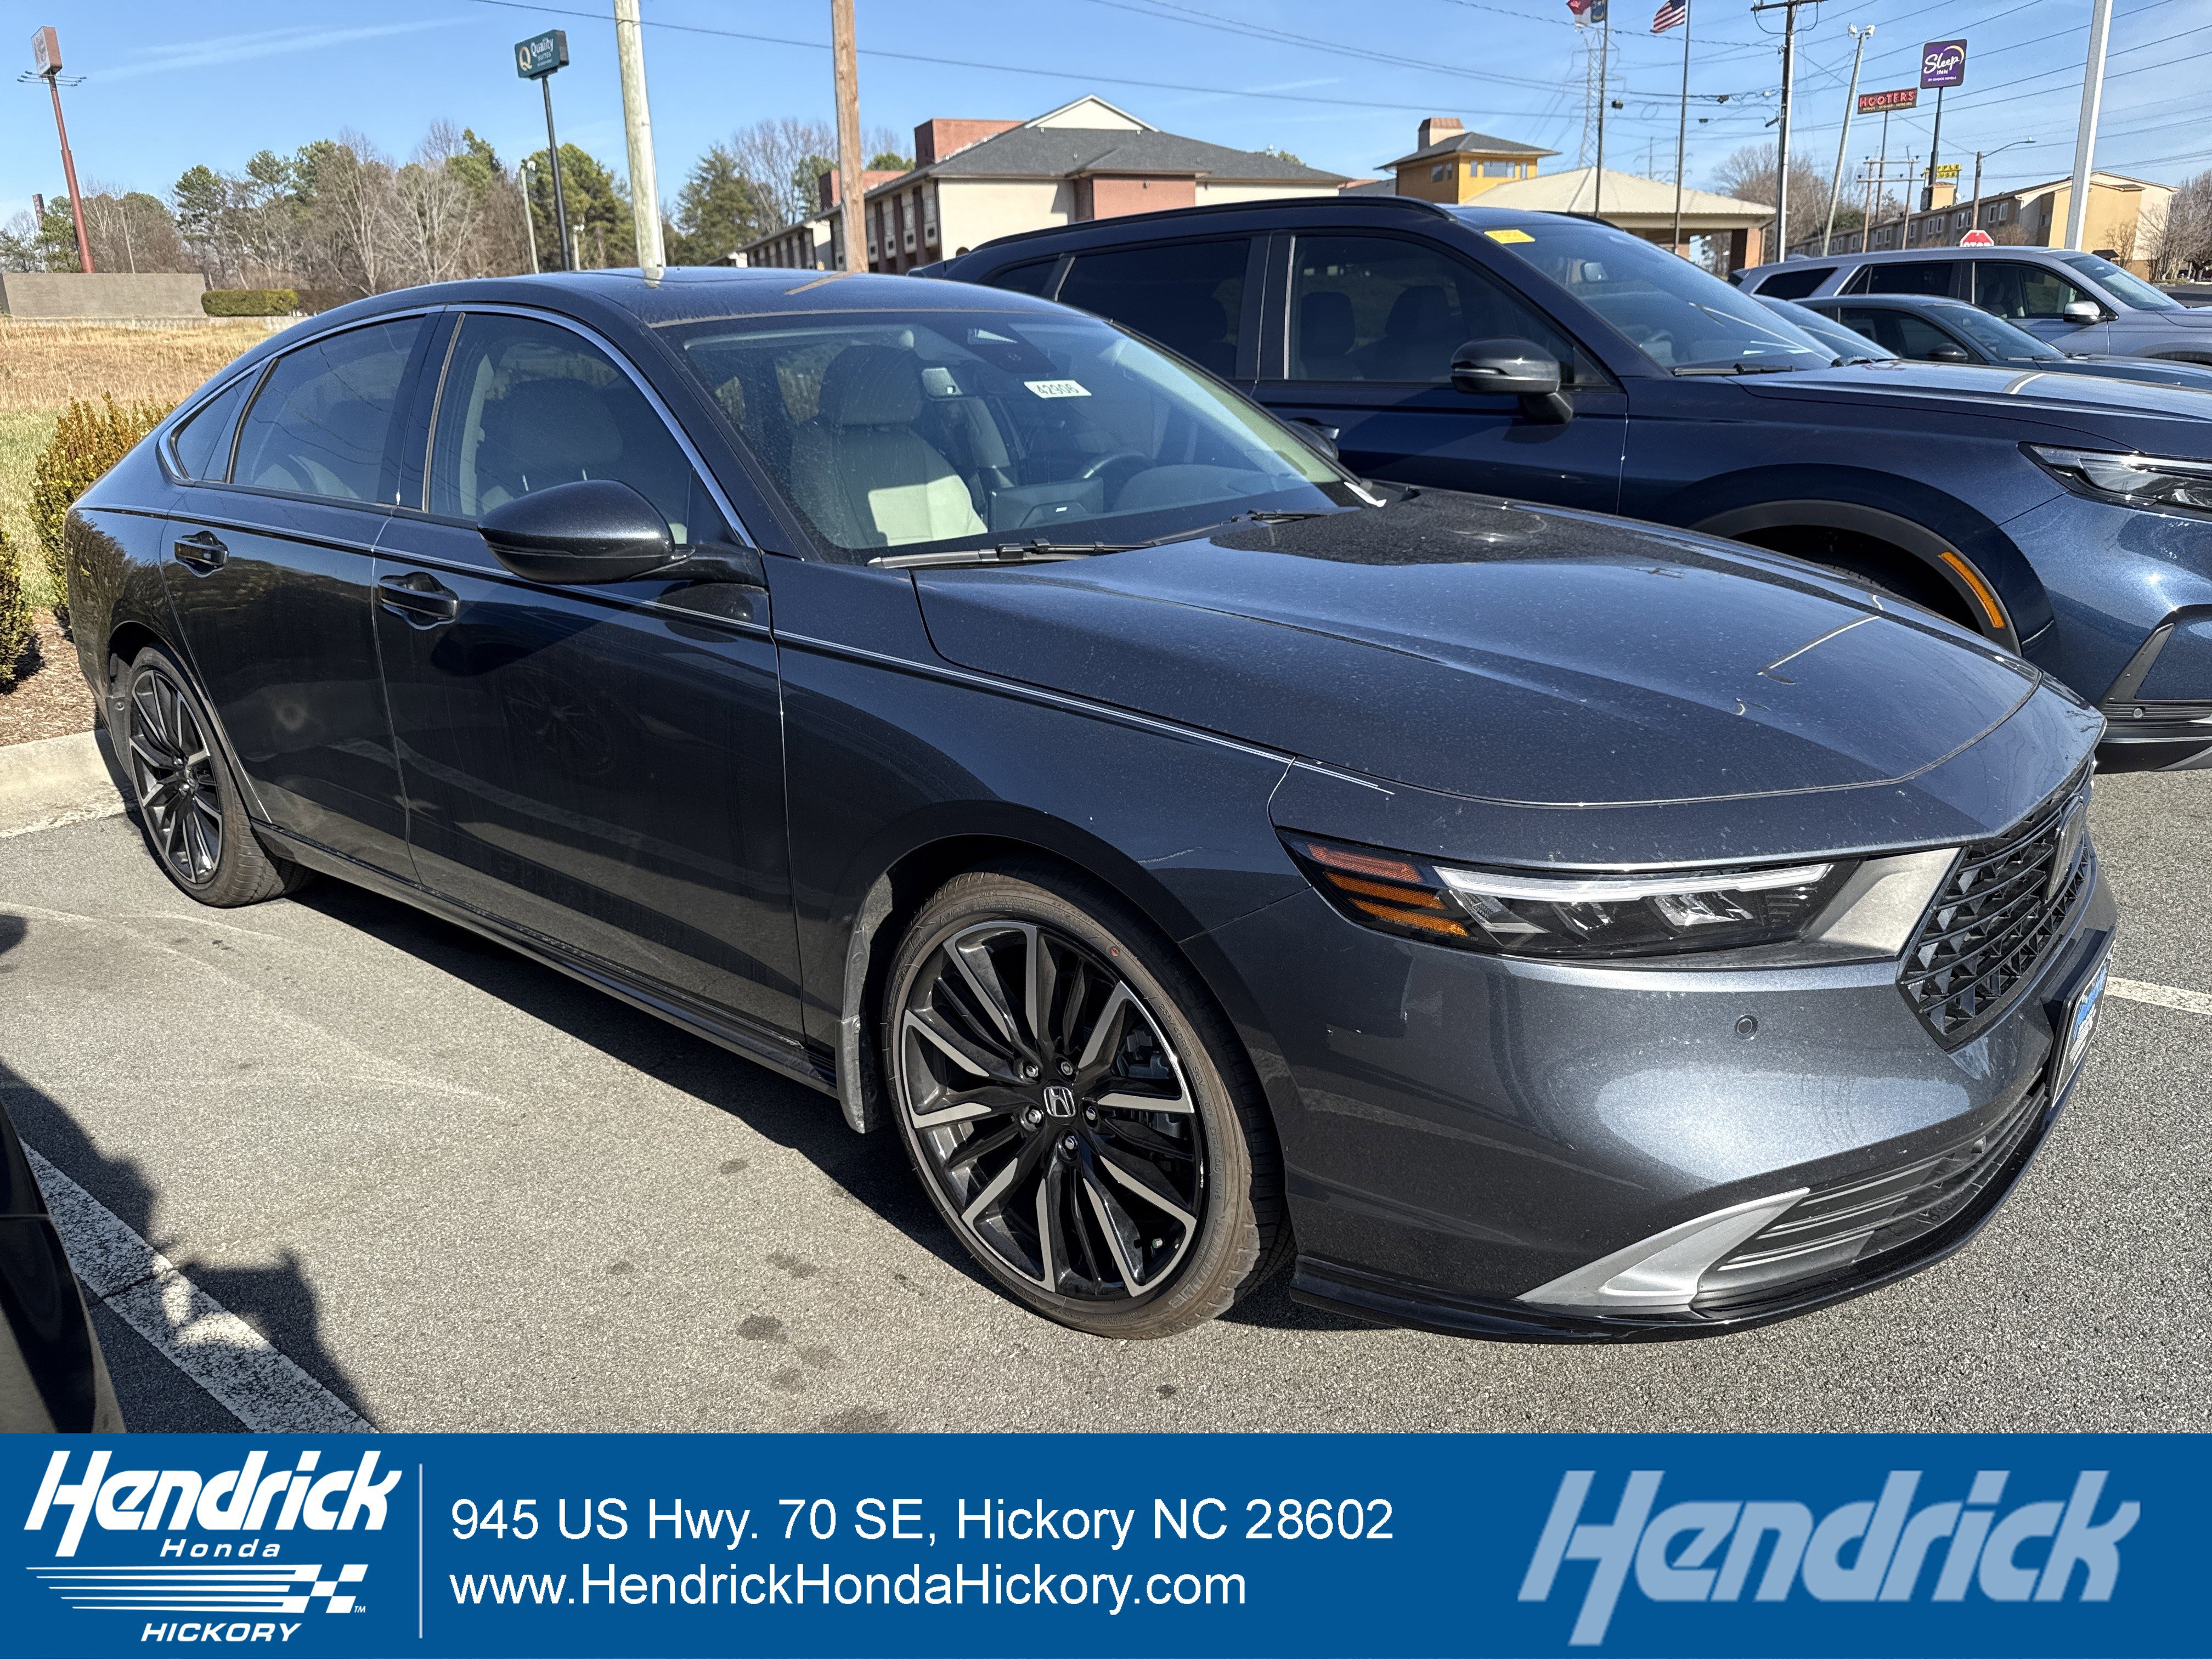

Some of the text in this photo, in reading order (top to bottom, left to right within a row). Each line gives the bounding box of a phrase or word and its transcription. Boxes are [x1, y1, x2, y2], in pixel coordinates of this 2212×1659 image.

[530, 37, 554, 57] Quality
[519, 46, 532, 71] Q
[1923, 52, 1960, 74] Sleep
[1859, 91, 1915, 108] HOOTERS
[1036, 383, 1079, 395] 42906
[1159, 1003, 1205, 1087] 235/40R19 96V
[1209, 1126, 1220, 1152] EXTRA
[1213, 1152, 1222, 1173] LOAD
